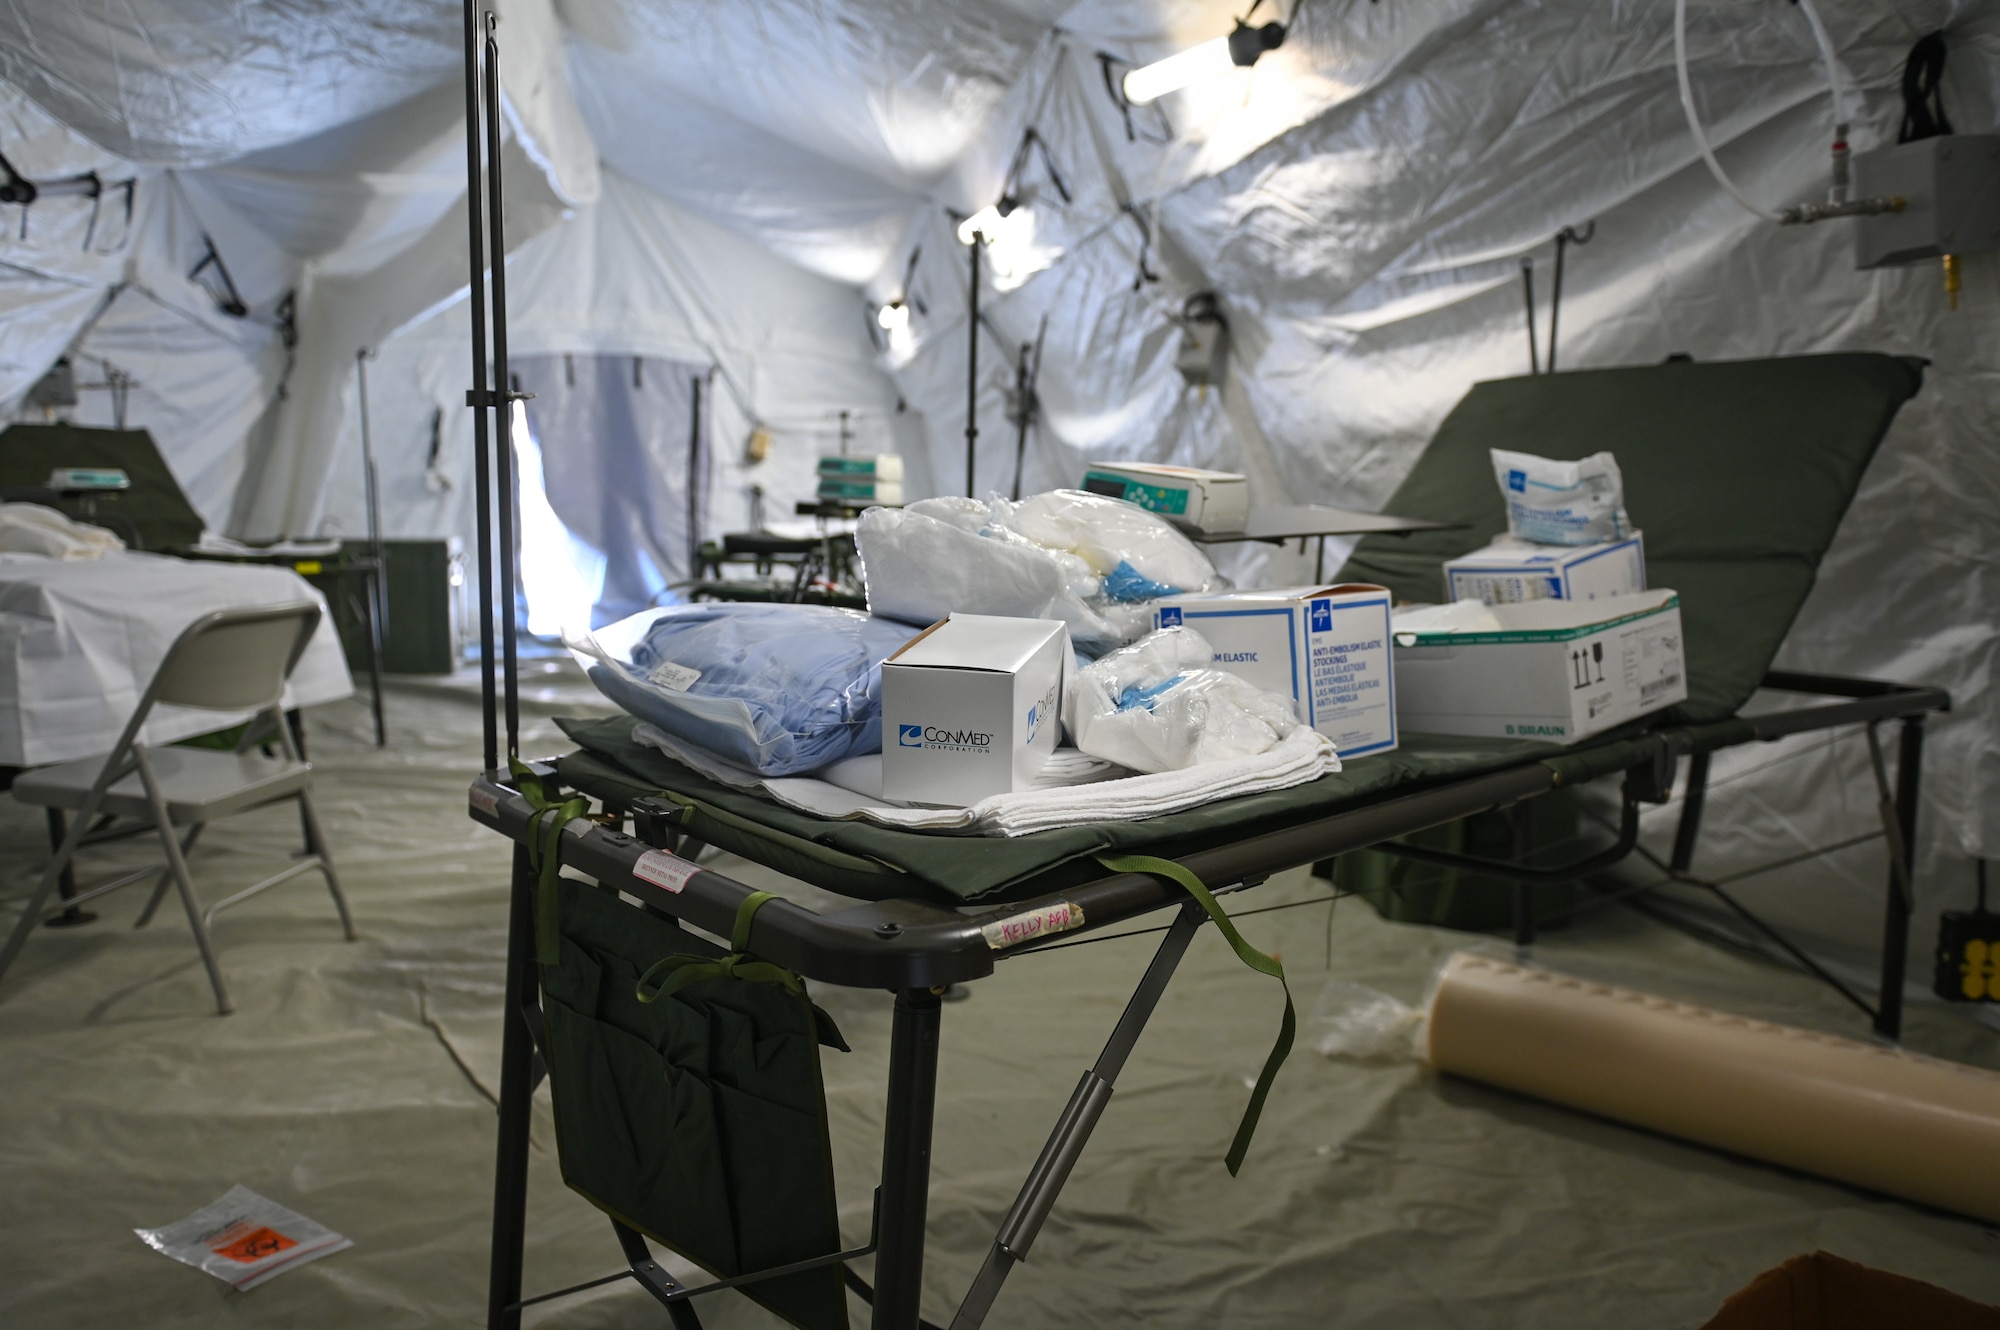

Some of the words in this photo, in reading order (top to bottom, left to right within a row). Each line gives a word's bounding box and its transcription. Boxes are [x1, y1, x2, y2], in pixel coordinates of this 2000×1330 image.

[1313, 642, 1360, 656] ANTI-EMBOLISM
[1361, 640, 1382, 651] ELASTIC
[1223, 652, 1258, 662] ELASTIC
[1313, 655, 1347, 667] STOCKINGS
[1314, 668, 1321, 677] LE
[1322, 665, 1335, 676] BAS
[1315, 687, 1327, 698] LAS
[1328, 684, 1351, 696] MEDIAS
[1518, 724, 1565, 736] BRAUN
[924, 744, 990, 754] CORPORATION
[1002, 916, 1042, 941] KELLY
[1049, 909, 1069, 928] AFB
